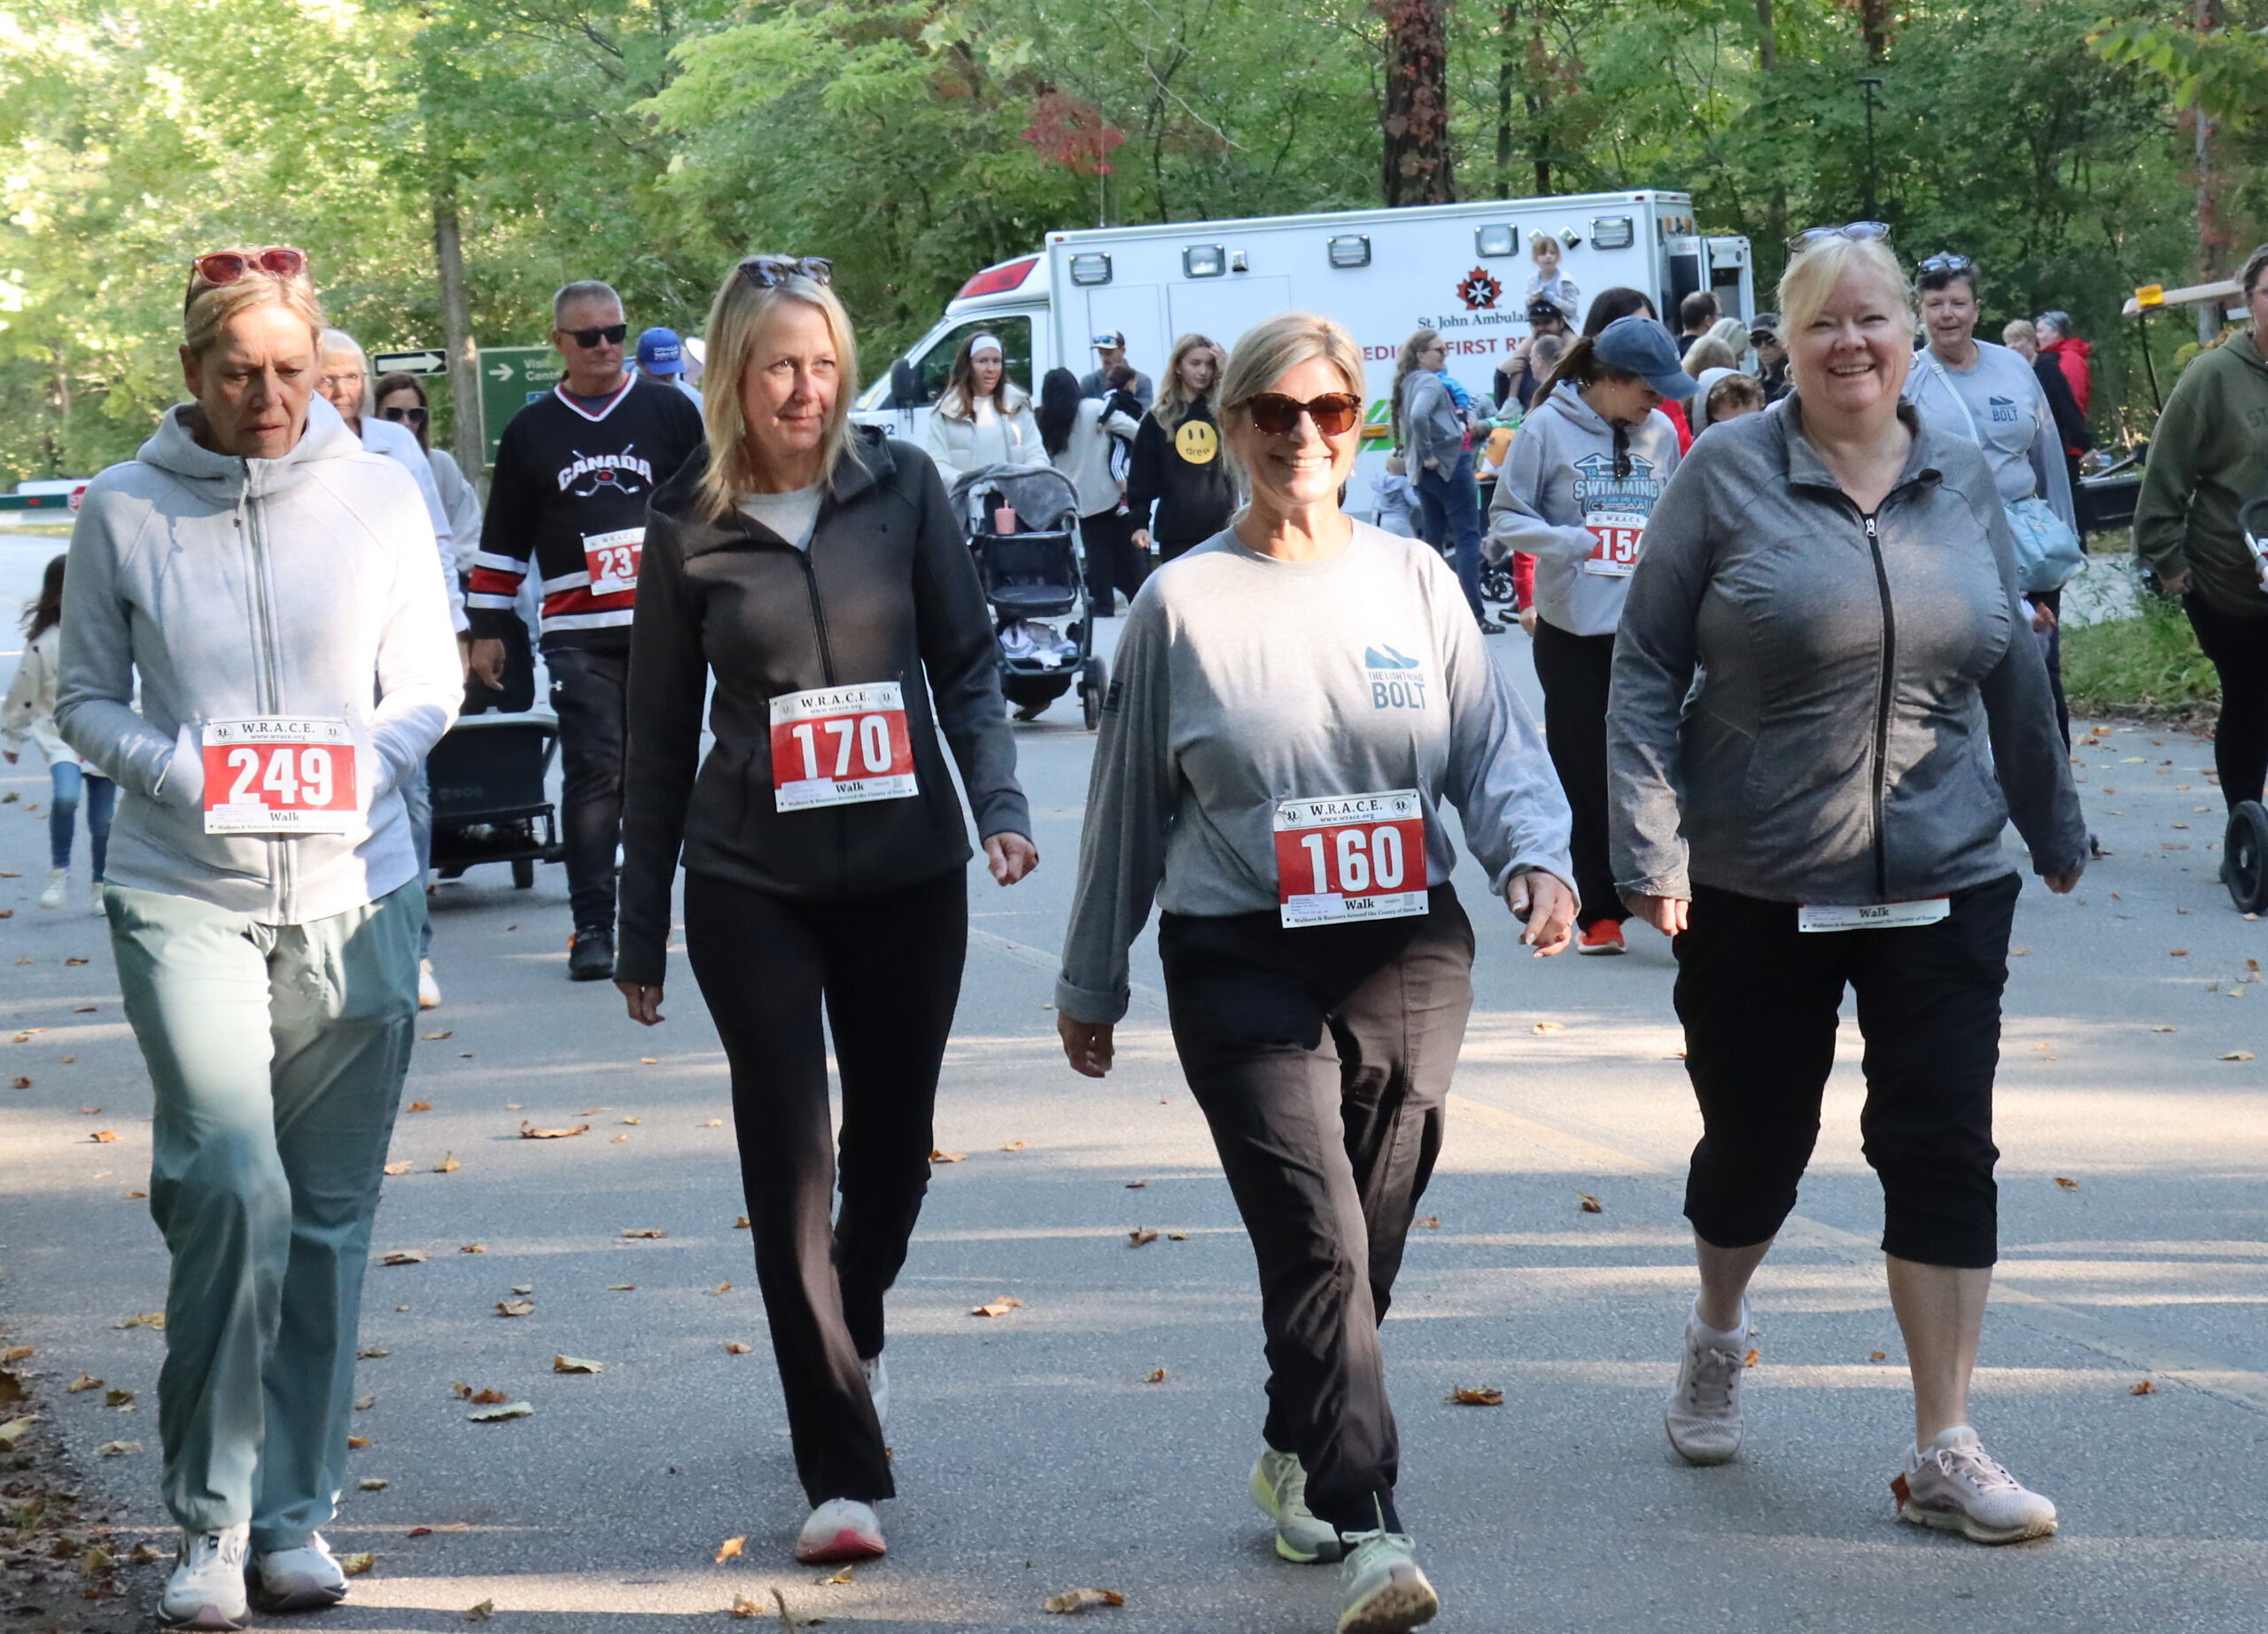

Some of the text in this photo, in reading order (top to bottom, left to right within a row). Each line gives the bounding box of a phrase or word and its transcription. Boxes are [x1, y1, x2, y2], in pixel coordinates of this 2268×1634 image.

[1418, 312, 1531, 331] St. John Ambula
[1445, 338, 1497, 356] FIRST
[1992, 409, 2018, 422] BOLT
[1185, 446, 1210, 456] drew
[557, 455, 653, 492] CANADA
[1574, 479, 1659, 500] SWIMMING
[1368, 671, 1383, 681] THE
[800, 691, 871, 708] W.R.A.C.E.
[1371, 681, 1425, 710] BOLT
[242, 722, 315, 734] W.R.A.C.E.
[792, 714, 892, 780] 170
[228, 747, 333, 805] 249
[835, 782, 865, 793] Walk
[1309, 799, 1384, 816] W.R.A.C.E.
[269, 813, 300, 821] Walk
[1320, 813, 1375, 823] www.wrace.org
[1301, 825, 1404, 894] 160
[1346, 898, 1375, 910] Walk
[1859, 906, 1890, 918] Walk
